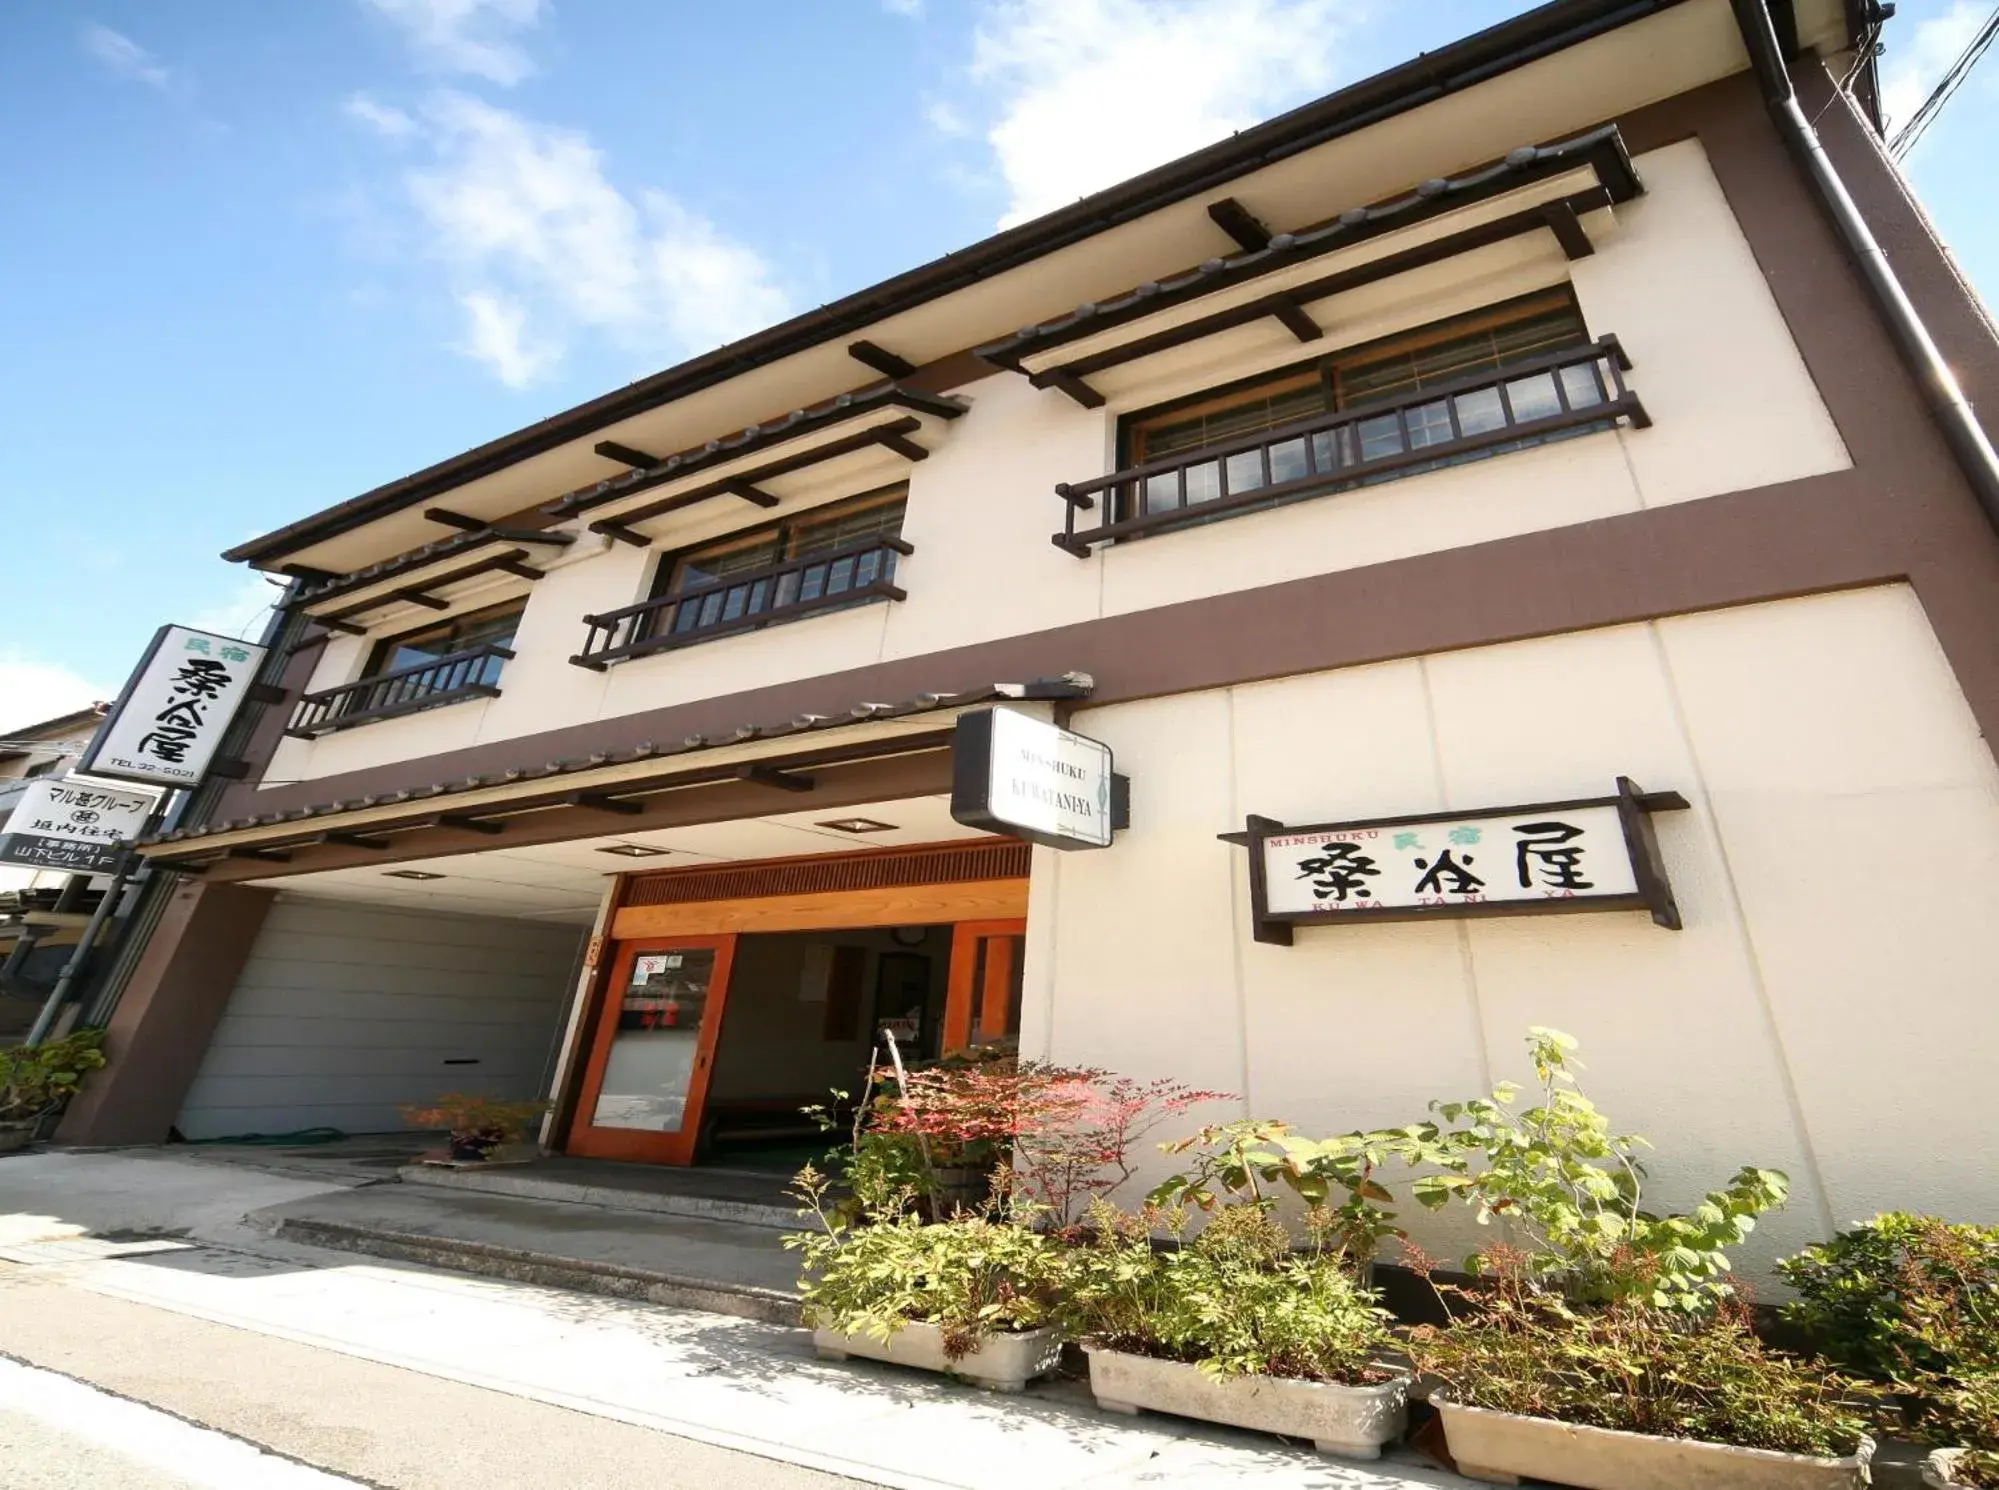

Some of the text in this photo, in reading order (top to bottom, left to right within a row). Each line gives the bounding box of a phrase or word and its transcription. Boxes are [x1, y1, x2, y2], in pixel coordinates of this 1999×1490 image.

[138, 658, 233, 763] 桑谷屋
[110, 757, 196, 778] TEL 32-5021
[1270, 831, 1380, 848] MINSHUKU
[1295, 822, 1595, 902] 桑谷屋
[1355, 900, 1384, 910] WA
[1418, 896, 1448, 908] TA
